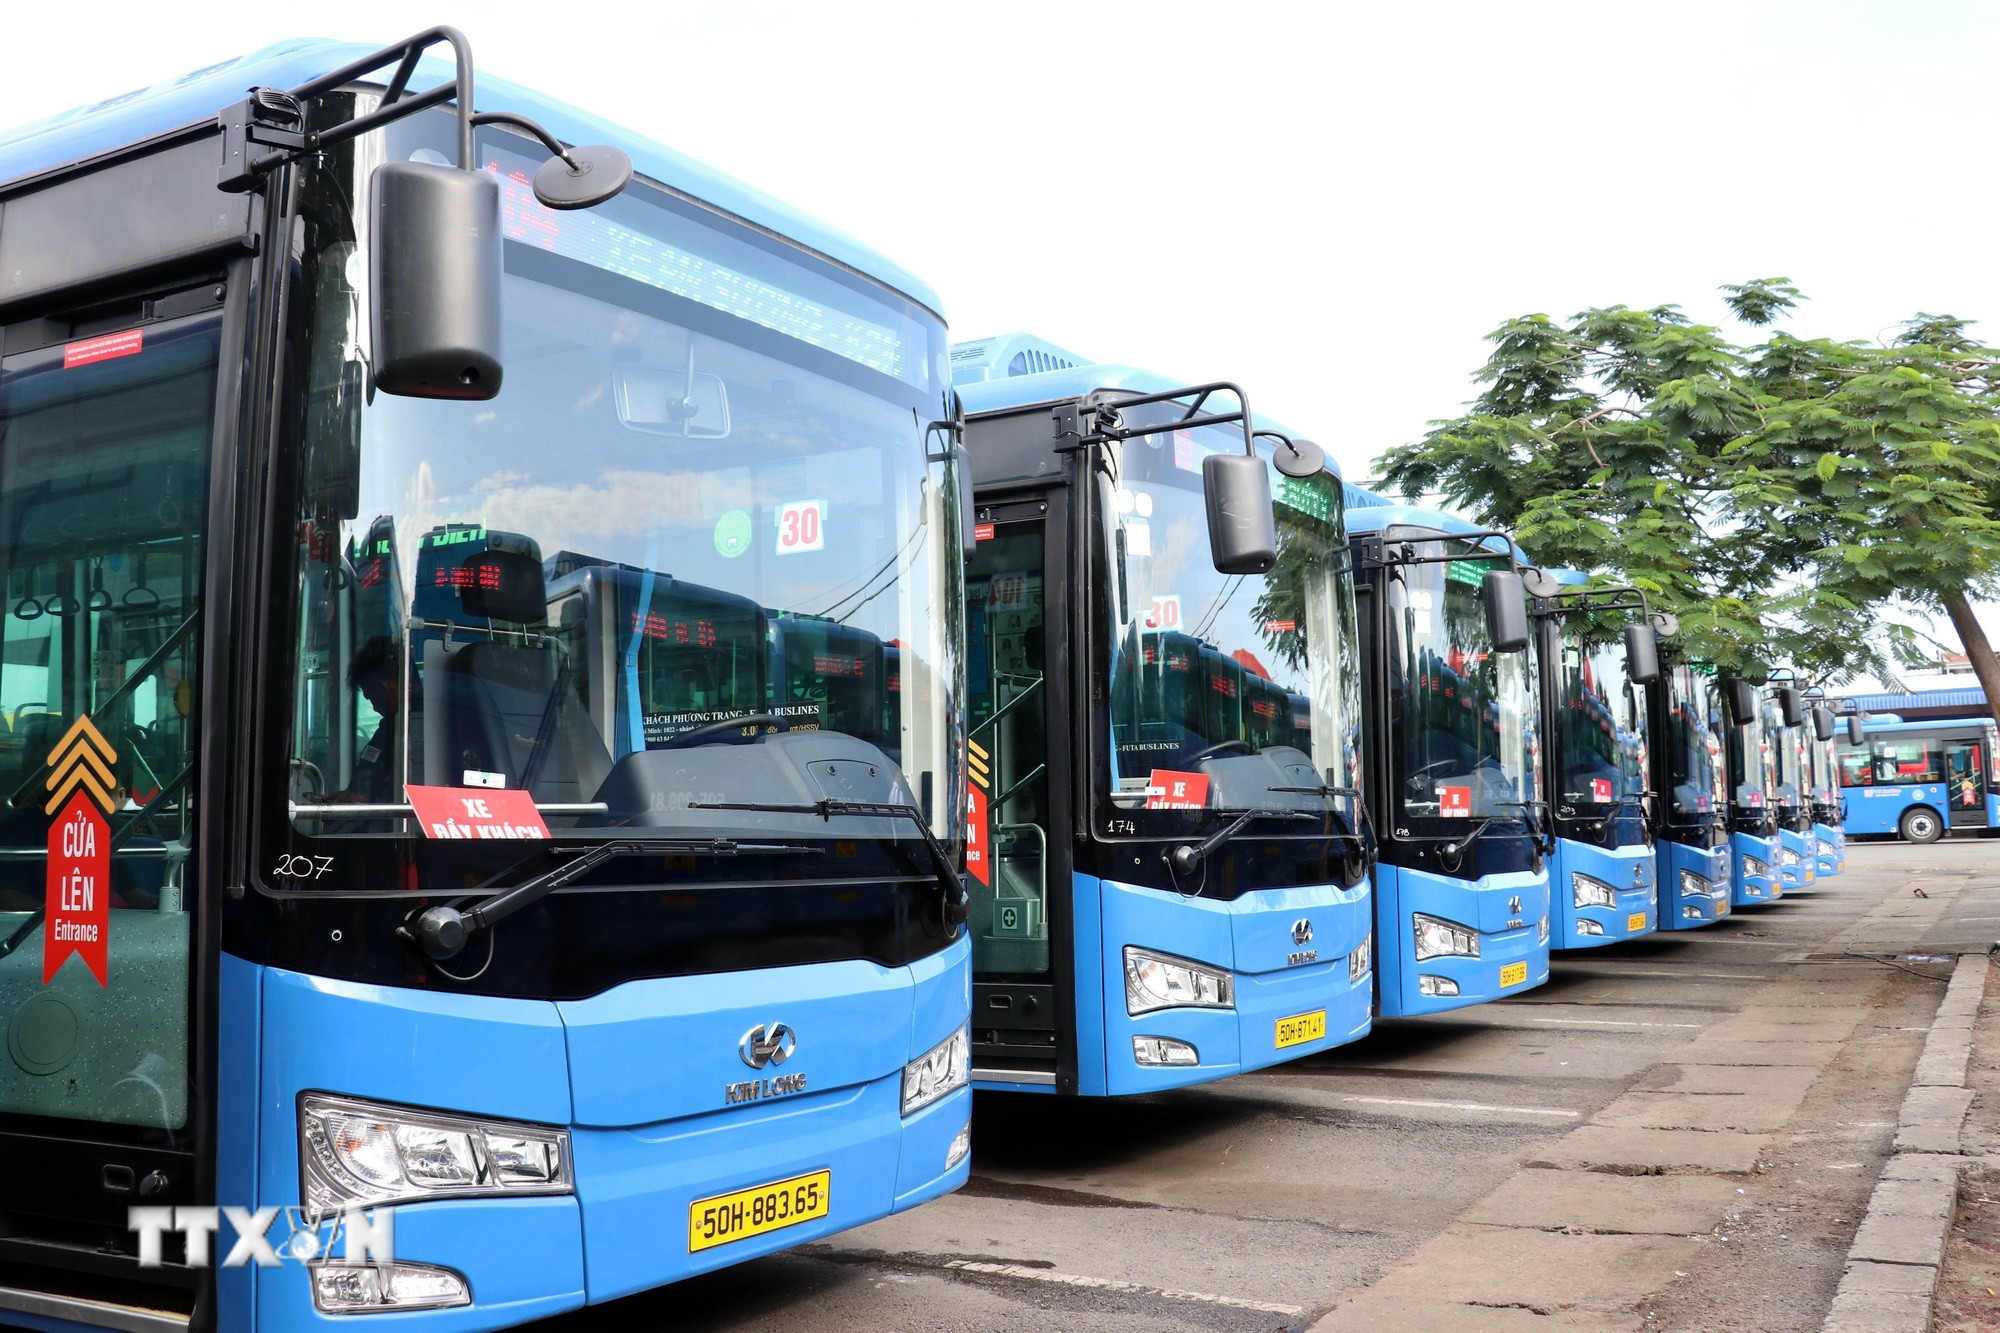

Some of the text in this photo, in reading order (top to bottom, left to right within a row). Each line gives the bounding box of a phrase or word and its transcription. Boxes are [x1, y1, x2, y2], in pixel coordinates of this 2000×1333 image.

[782, 507, 818, 546] 30
[1145, 600, 1178, 628] 30
[672, 712, 710, 723] PHƯƠNG
[711, 710, 743, 720] TRANG
[775, 705, 820, 717] BUSLINES
[1139, 743, 1180, 751] BUSLINES
[1173, 781, 1186, 797] XE
[460, 798, 493, 819] XE
[63, 809, 96, 858] CỬA
[1108, 819, 1135, 835] 174
[273, 853, 334, 879] 207
[61, 866, 95, 911] LÊN
[55, 918, 98, 942] Entrance
[1279, 1016, 1323, 1042] 50H-871.41
[725, 1072, 807, 1104] KIM LONG
[703, 1182, 819, 1239] 50H-883.65
